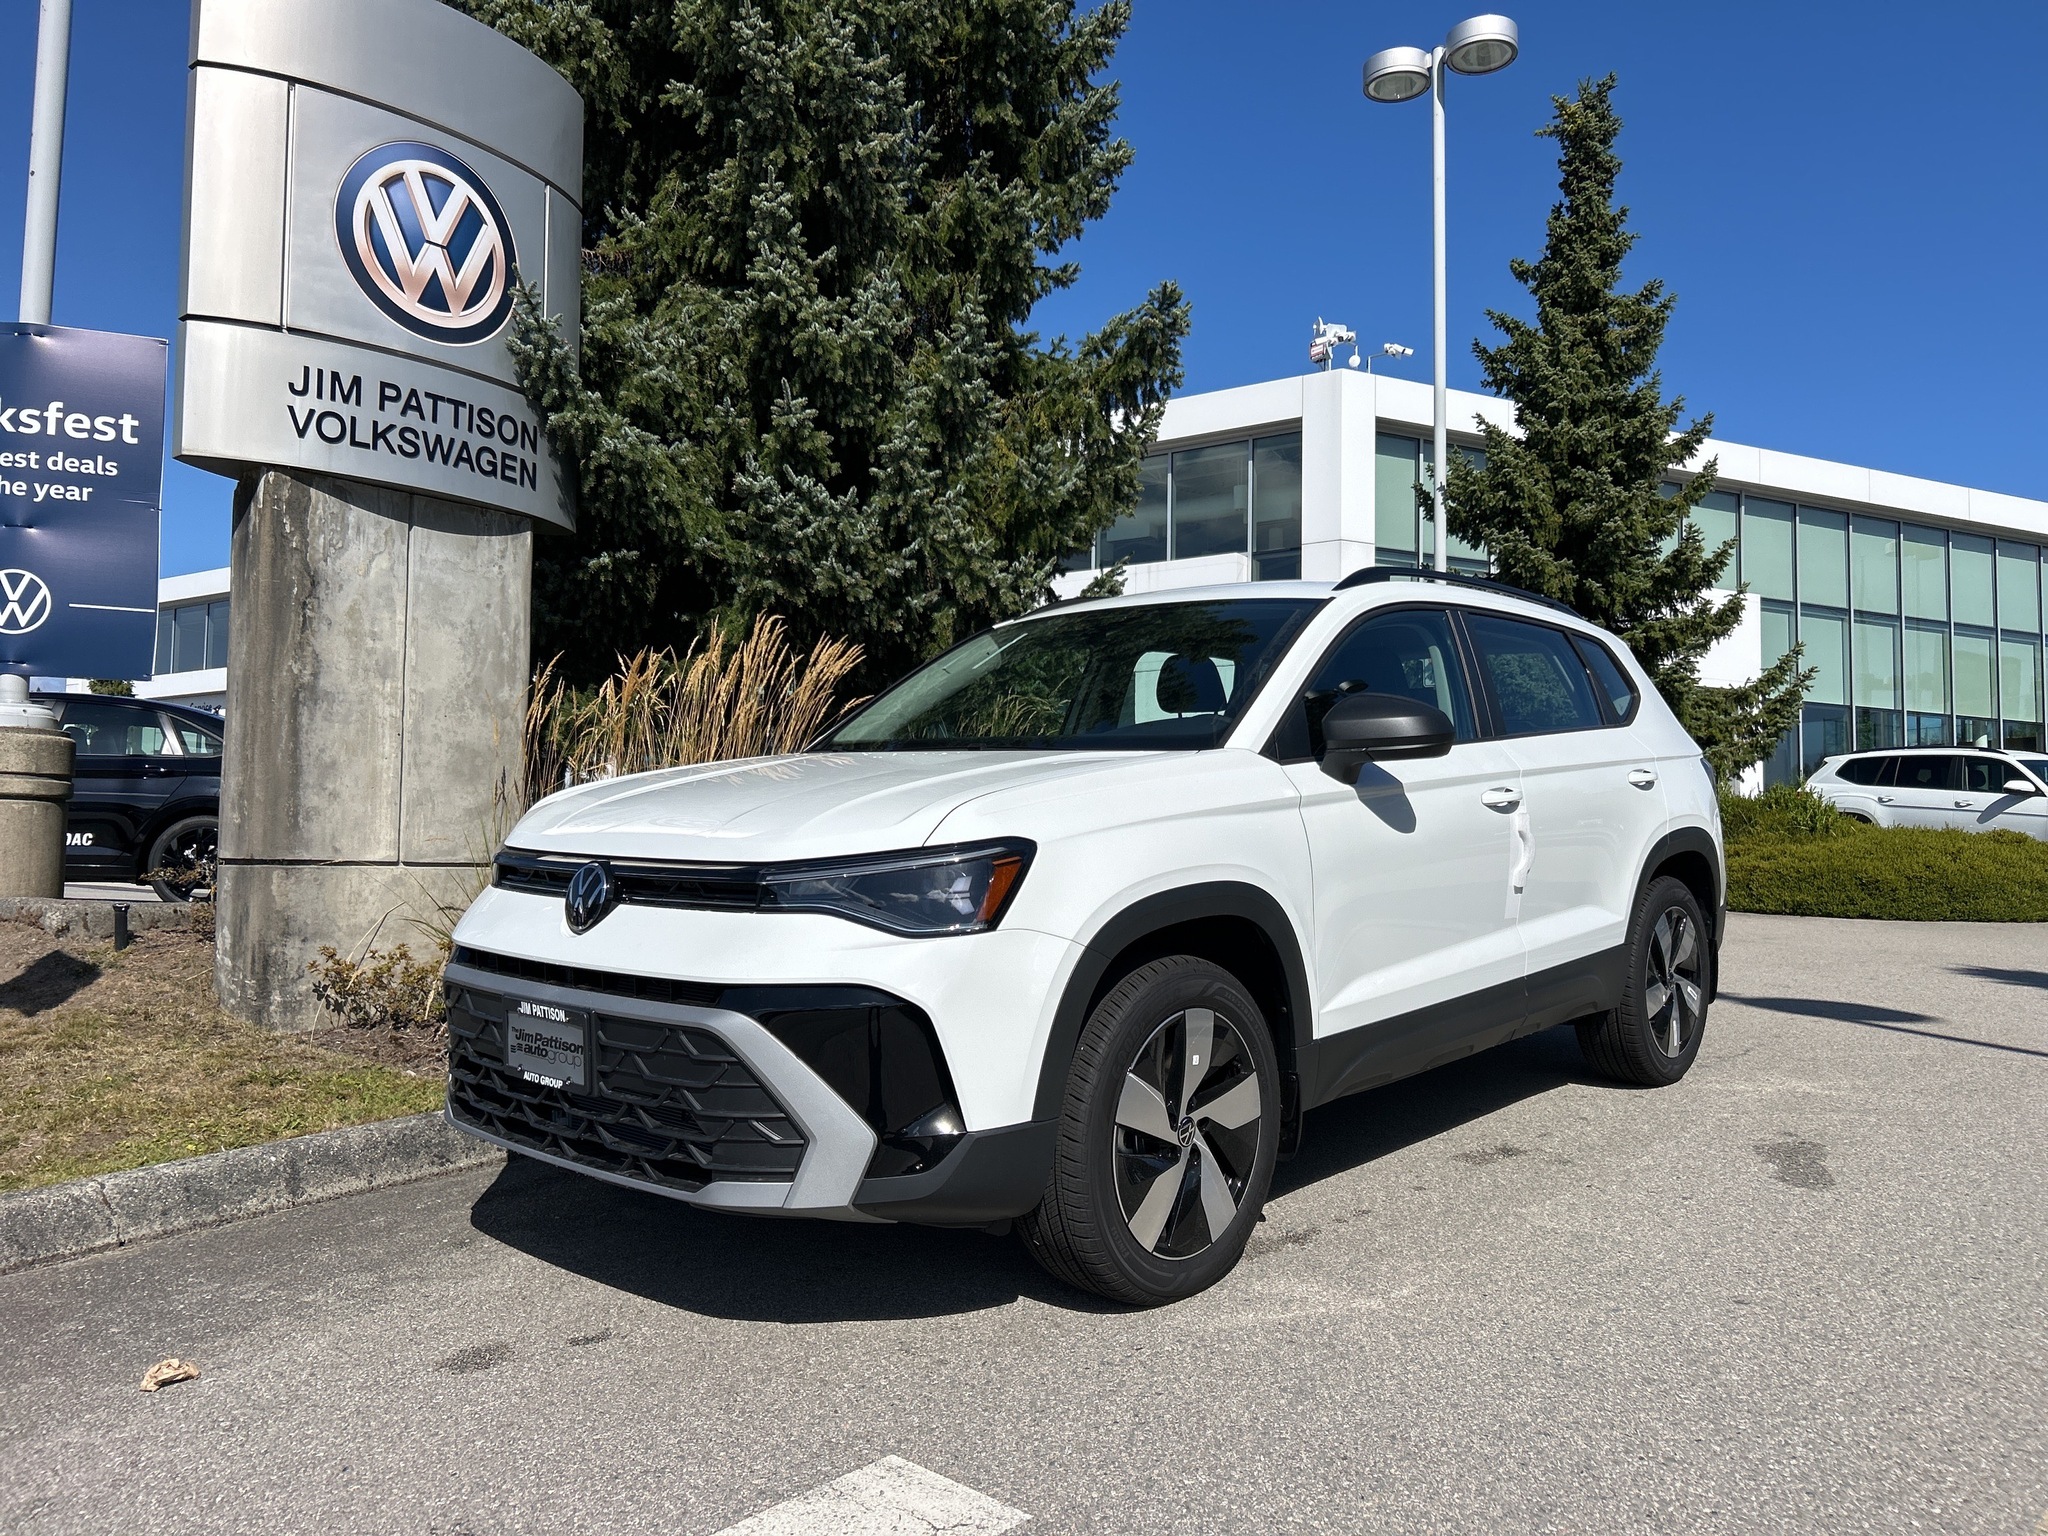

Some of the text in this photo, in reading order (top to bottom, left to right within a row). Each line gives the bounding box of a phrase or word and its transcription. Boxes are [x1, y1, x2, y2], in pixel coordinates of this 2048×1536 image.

[288, 365, 538, 455] JIM PATTISON
[287, 404, 537, 492] VOLKSWAGEN
[46, 451, 118, 476] deals
[33, 482, 93, 502] year
[520, 1001, 566, 1022] JIM PATTISON
[523, 1071, 563, 1089] AUTO GROUP
